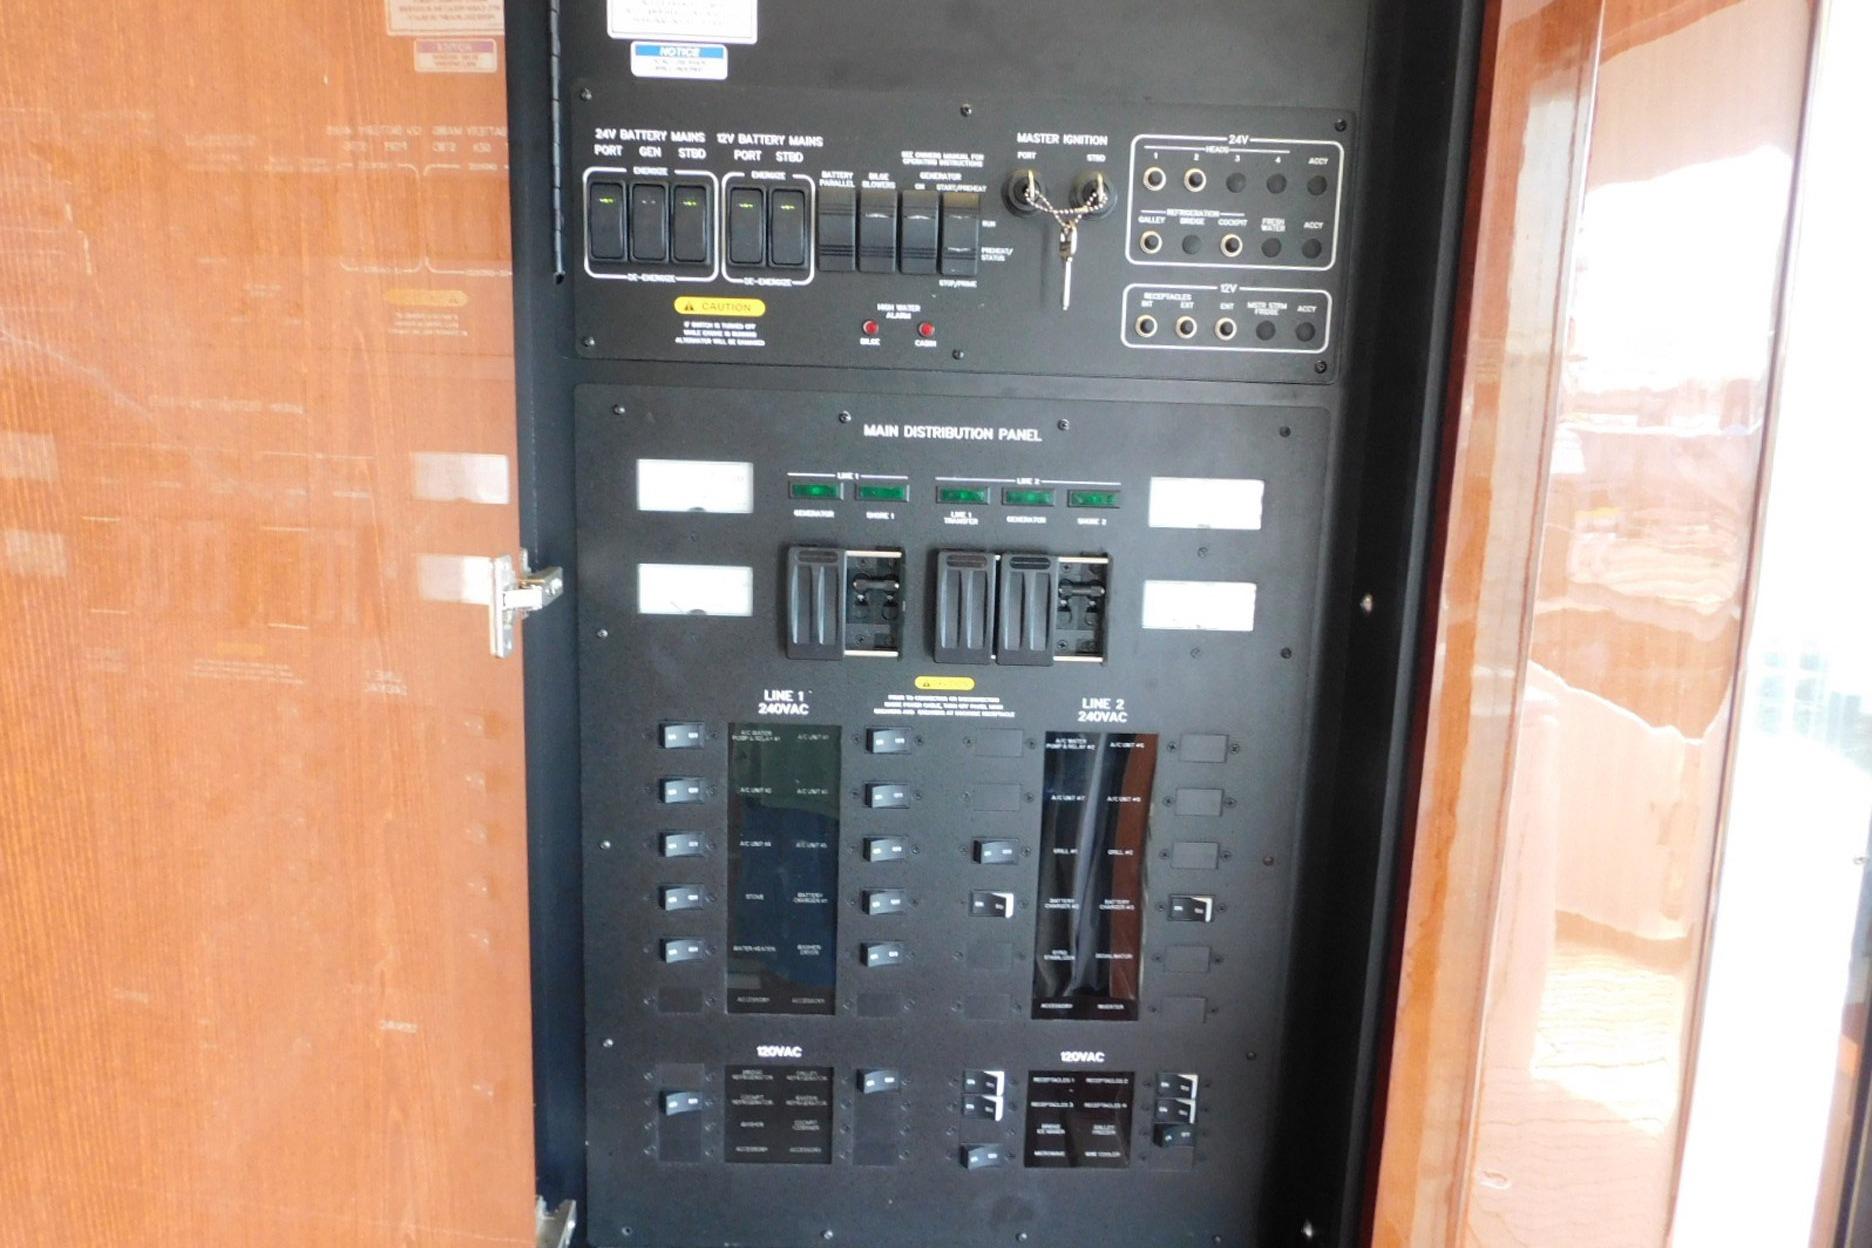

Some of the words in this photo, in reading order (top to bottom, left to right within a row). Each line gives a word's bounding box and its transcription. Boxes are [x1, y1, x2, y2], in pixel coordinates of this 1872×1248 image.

[595, 128, 616, 139] 24V
[620, 129, 667, 141] BATTERY
[671, 132, 705, 142] MAINS
[717, 133, 735, 144] 12V
[738, 134, 784, 145] BATTERY
[789, 136, 823, 147] MAINS
[1017, 133, 1059, 144] MASTER
[1063, 134, 1108, 145] IGNITION
[1229, 135, 1250, 144] 24V
[594, 145, 623, 156] PORT
[639, 146, 661, 157] GEN
[679, 148, 706, 159] STBD
[734, 150, 762, 160] PORT
[776, 151, 803, 162] STBD
[1153, 152, 1159, 160] 1
[1194, 153, 1199, 161] 2
[821, 171, 853, 180] BATTERY
[869, 173, 889, 182] BILGE
[920, 172, 962, 180] GENERATOR
[819, 179, 855, 188] PARALLEL
[862, 180, 896, 189] BLOWERS
[1166, 209, 1220, 218] REFRIGERATION
[1138, 216, 1165, 224] GALLEY
[1261, 218, 1285, 226] FRESH
[1261, 224, 1285, 232] WATER
[1220, 283, 1237, 293] 12V
[1143, 293, 1192, 301] RECEPTACLES
[701, 302, 752, 312] CAUTION
[877, 303, 894, 312] HIGH
[896, 304, 921, 313] WATER
[885, 311, 912, 319] ALARM
[864, 424, 899, 437] MAIN
[904, 426, 993, 439] DISTRIBUTION
[998, 428, 1042, 441] PANEL
[944, 517, 978, 525] TRANSFER
[764, 690, 794, 702] LINE
[798, 691, 804, 702] 1
[758, 702, 809, 715] 240VAC
[1082, 698, 1111, 709] LINE
[1116, 699, 1124, 710] 2
[1078, 710, 1128, 722] 240VAC
[757, 1046, 802, 1057] 120VAC
[1061, 1051, 1105, 1062] 120VAC
